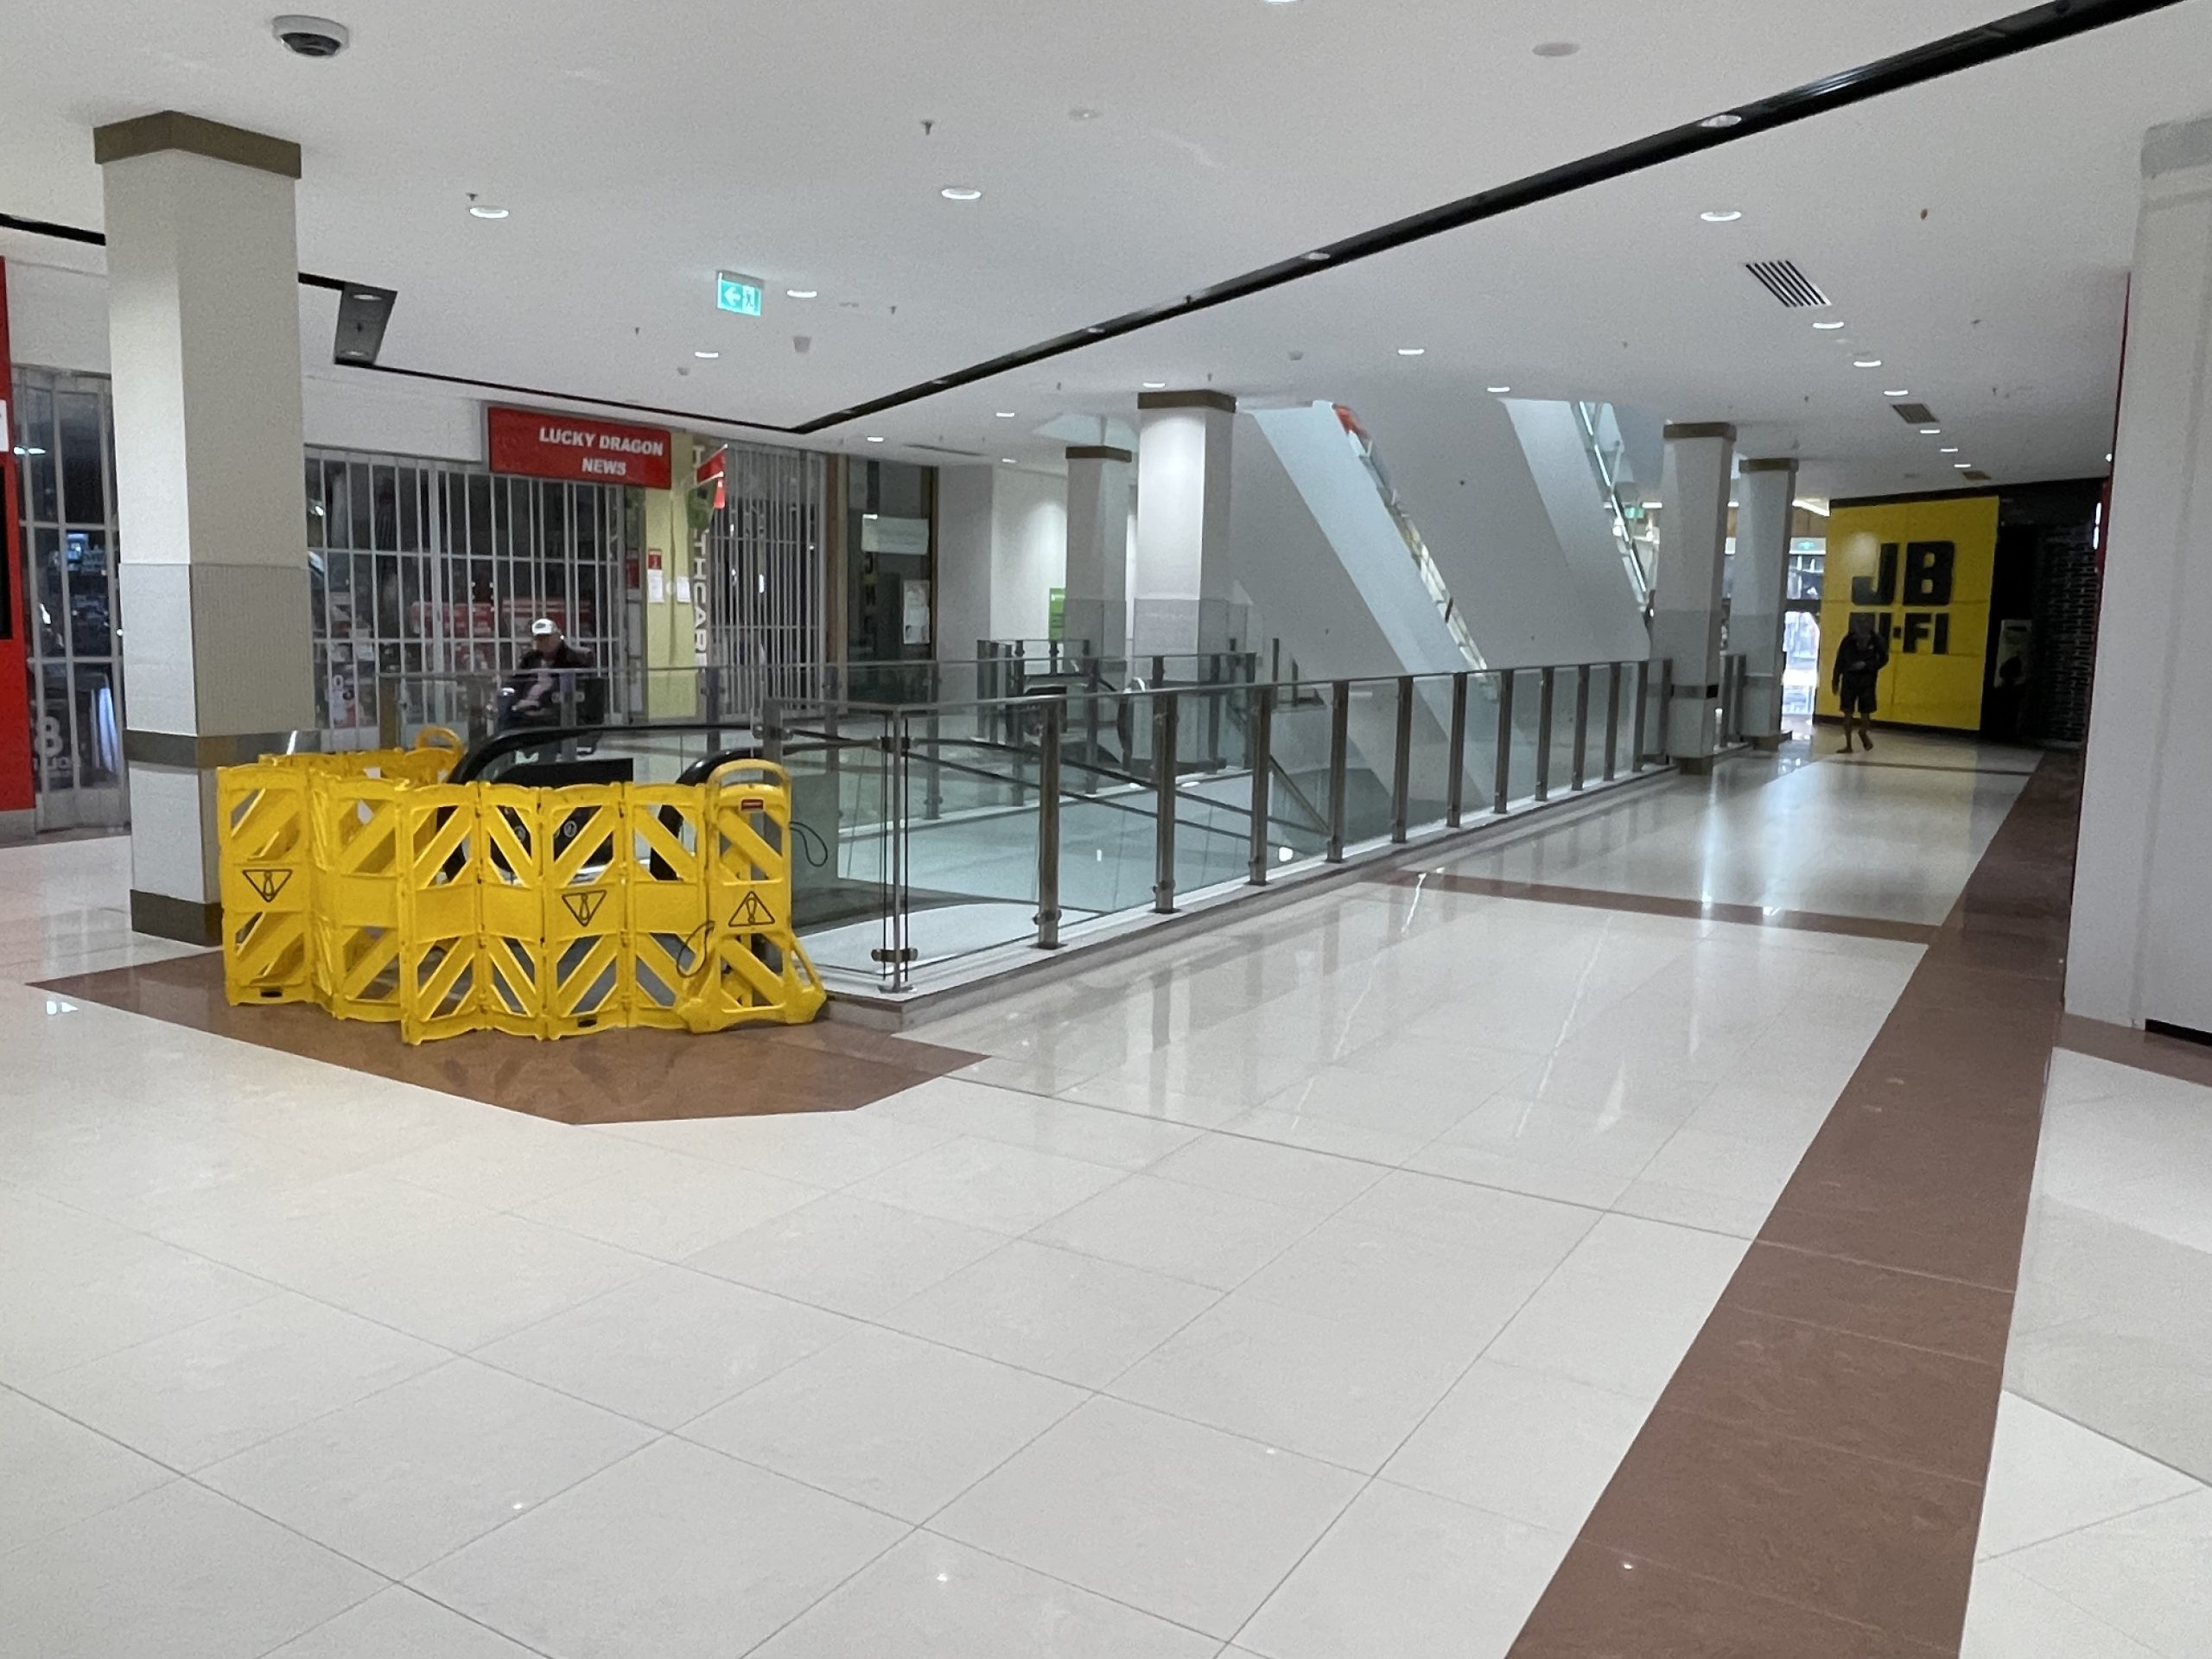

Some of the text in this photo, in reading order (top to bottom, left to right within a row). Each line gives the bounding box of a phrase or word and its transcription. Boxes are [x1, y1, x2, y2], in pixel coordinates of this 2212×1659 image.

[539, 427, 664, 456] LUCKY DRAGON
[582, 457, 626, 475] NEWS
[1851, 541, 1955, 607] JB
